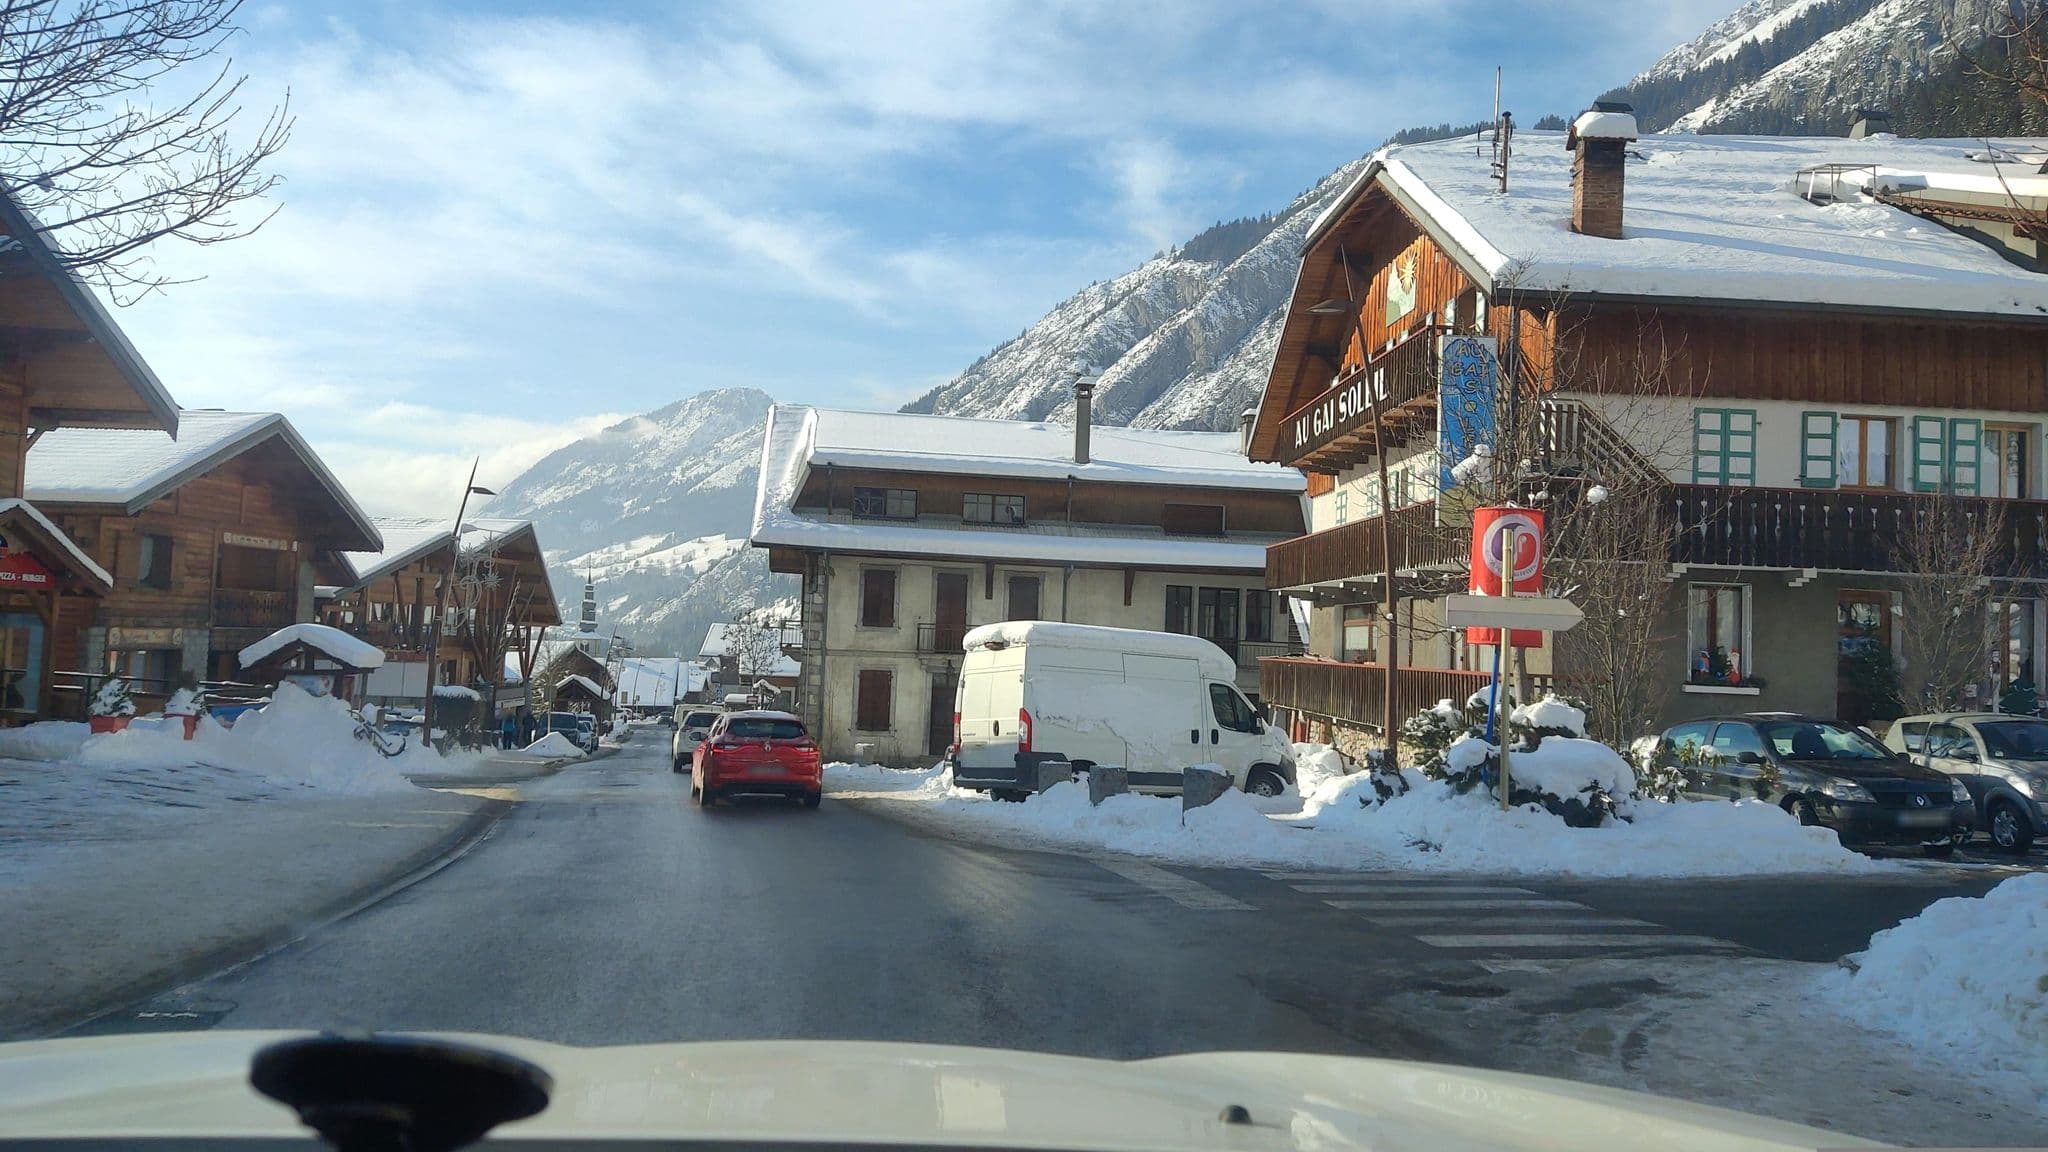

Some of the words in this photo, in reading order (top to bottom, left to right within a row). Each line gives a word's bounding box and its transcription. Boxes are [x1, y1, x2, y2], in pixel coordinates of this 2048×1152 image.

[1455, 342, 1486, 359] AU
[1450, 361, 1490, 378] GAI
[1295, 414, 1310, 449] AU
[1313, 398, 1334, 437] GAI
